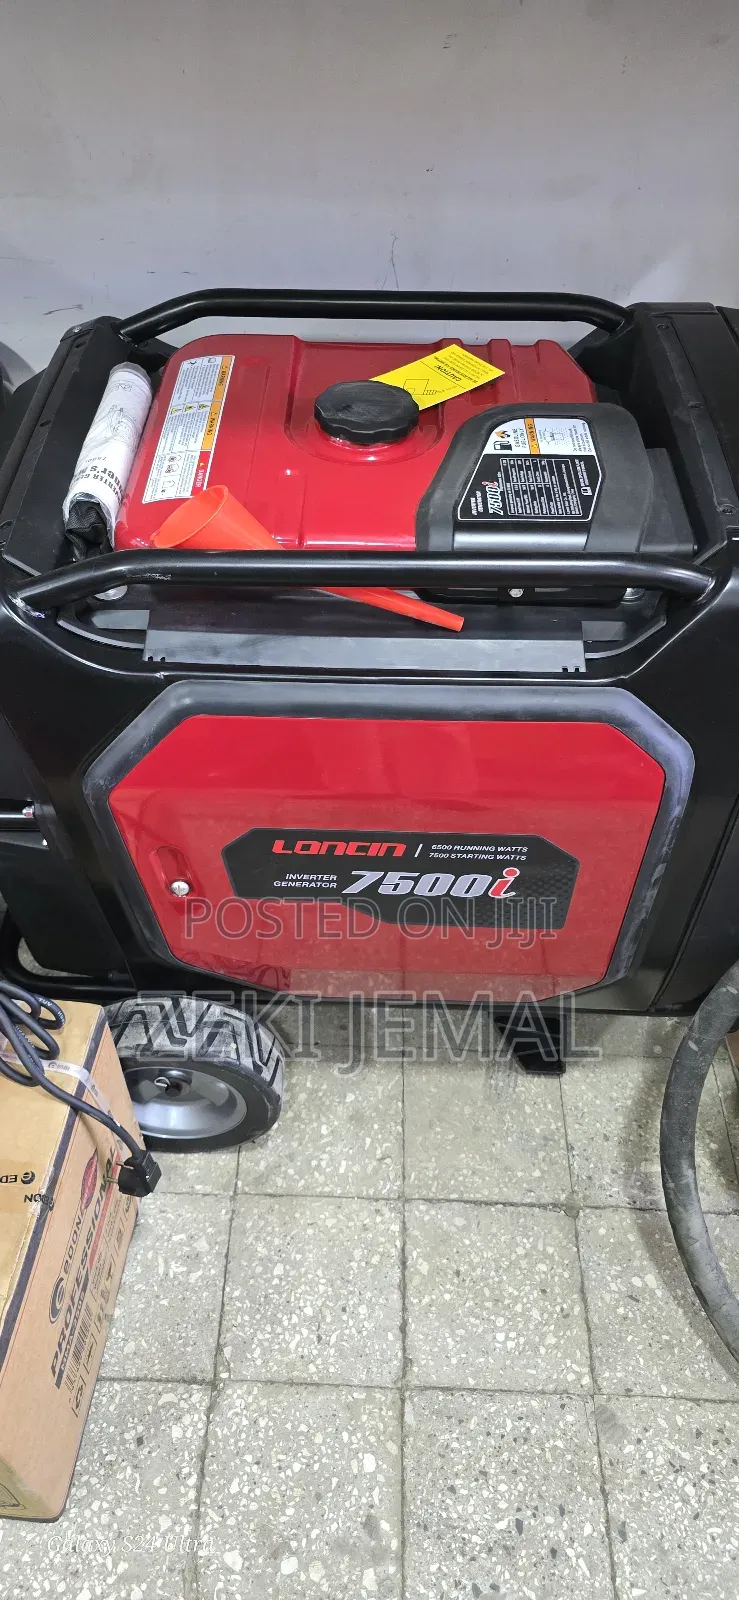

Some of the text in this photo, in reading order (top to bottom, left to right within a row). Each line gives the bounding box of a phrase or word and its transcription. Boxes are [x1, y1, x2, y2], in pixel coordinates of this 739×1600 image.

[481, 481, 504, 516] 7500i
[271, 840, 407, 857] LONCIN
[273, 881, 338, 889] GENERATOR
[285, 873, 338, 881] INVERTER
[341, 867, 520, 898] 7500i
[51, 1147, 117, 1378] PROFESSIONAL
